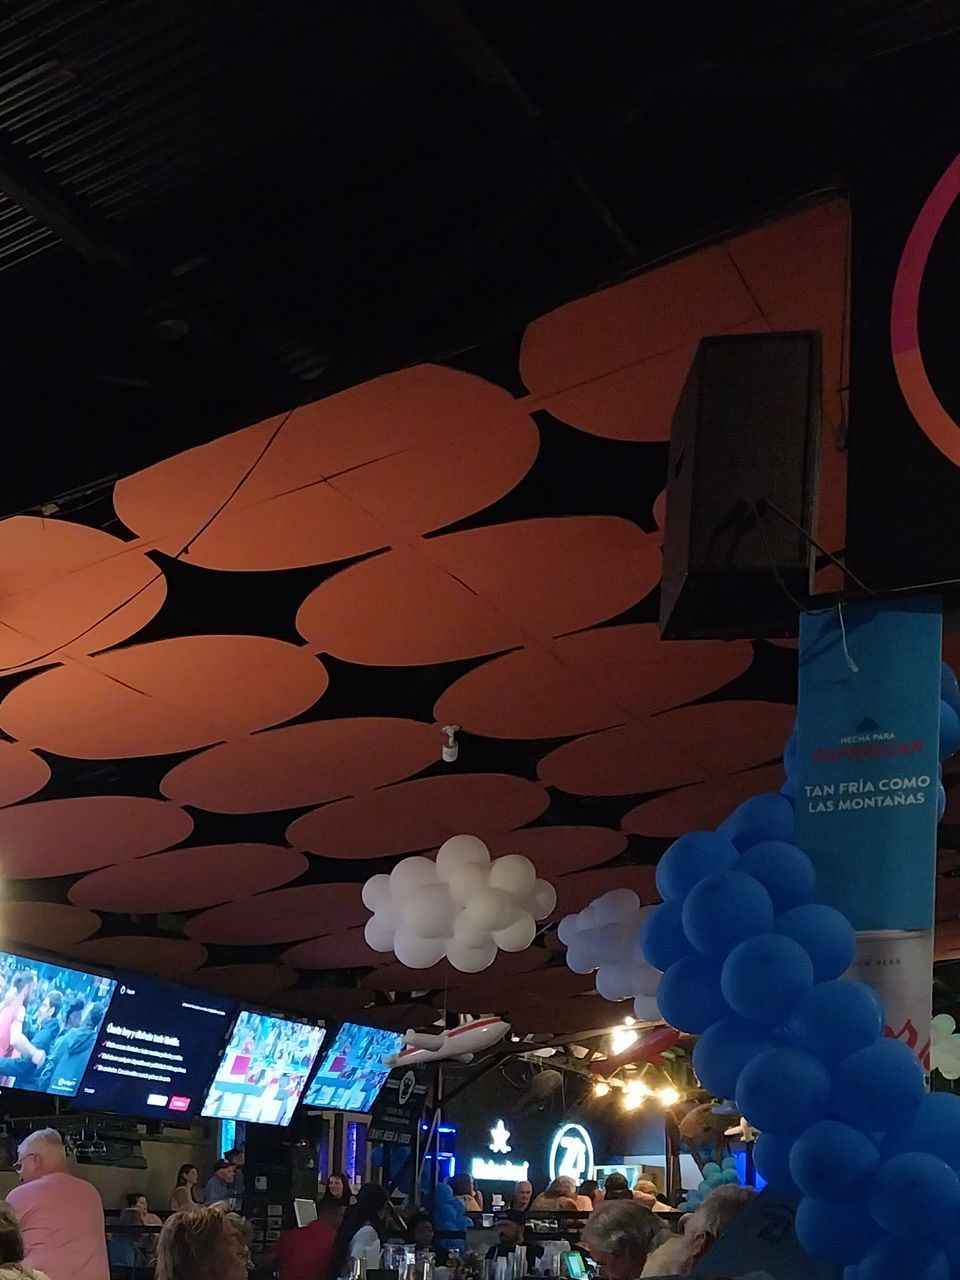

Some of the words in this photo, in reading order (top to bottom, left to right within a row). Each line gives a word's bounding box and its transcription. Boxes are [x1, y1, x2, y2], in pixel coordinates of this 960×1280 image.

[840, 735, 870, 745] HECHA
[873, 732, 896, 742] PARA
[804, 785, 834, 798] TAN
[840, 779, 875, 795] FRÍA
[878, 775, 931, 791] COMO
[808, 801, 835, 814] LAS
[838, 791, 926, 811] MONTAÑAS
